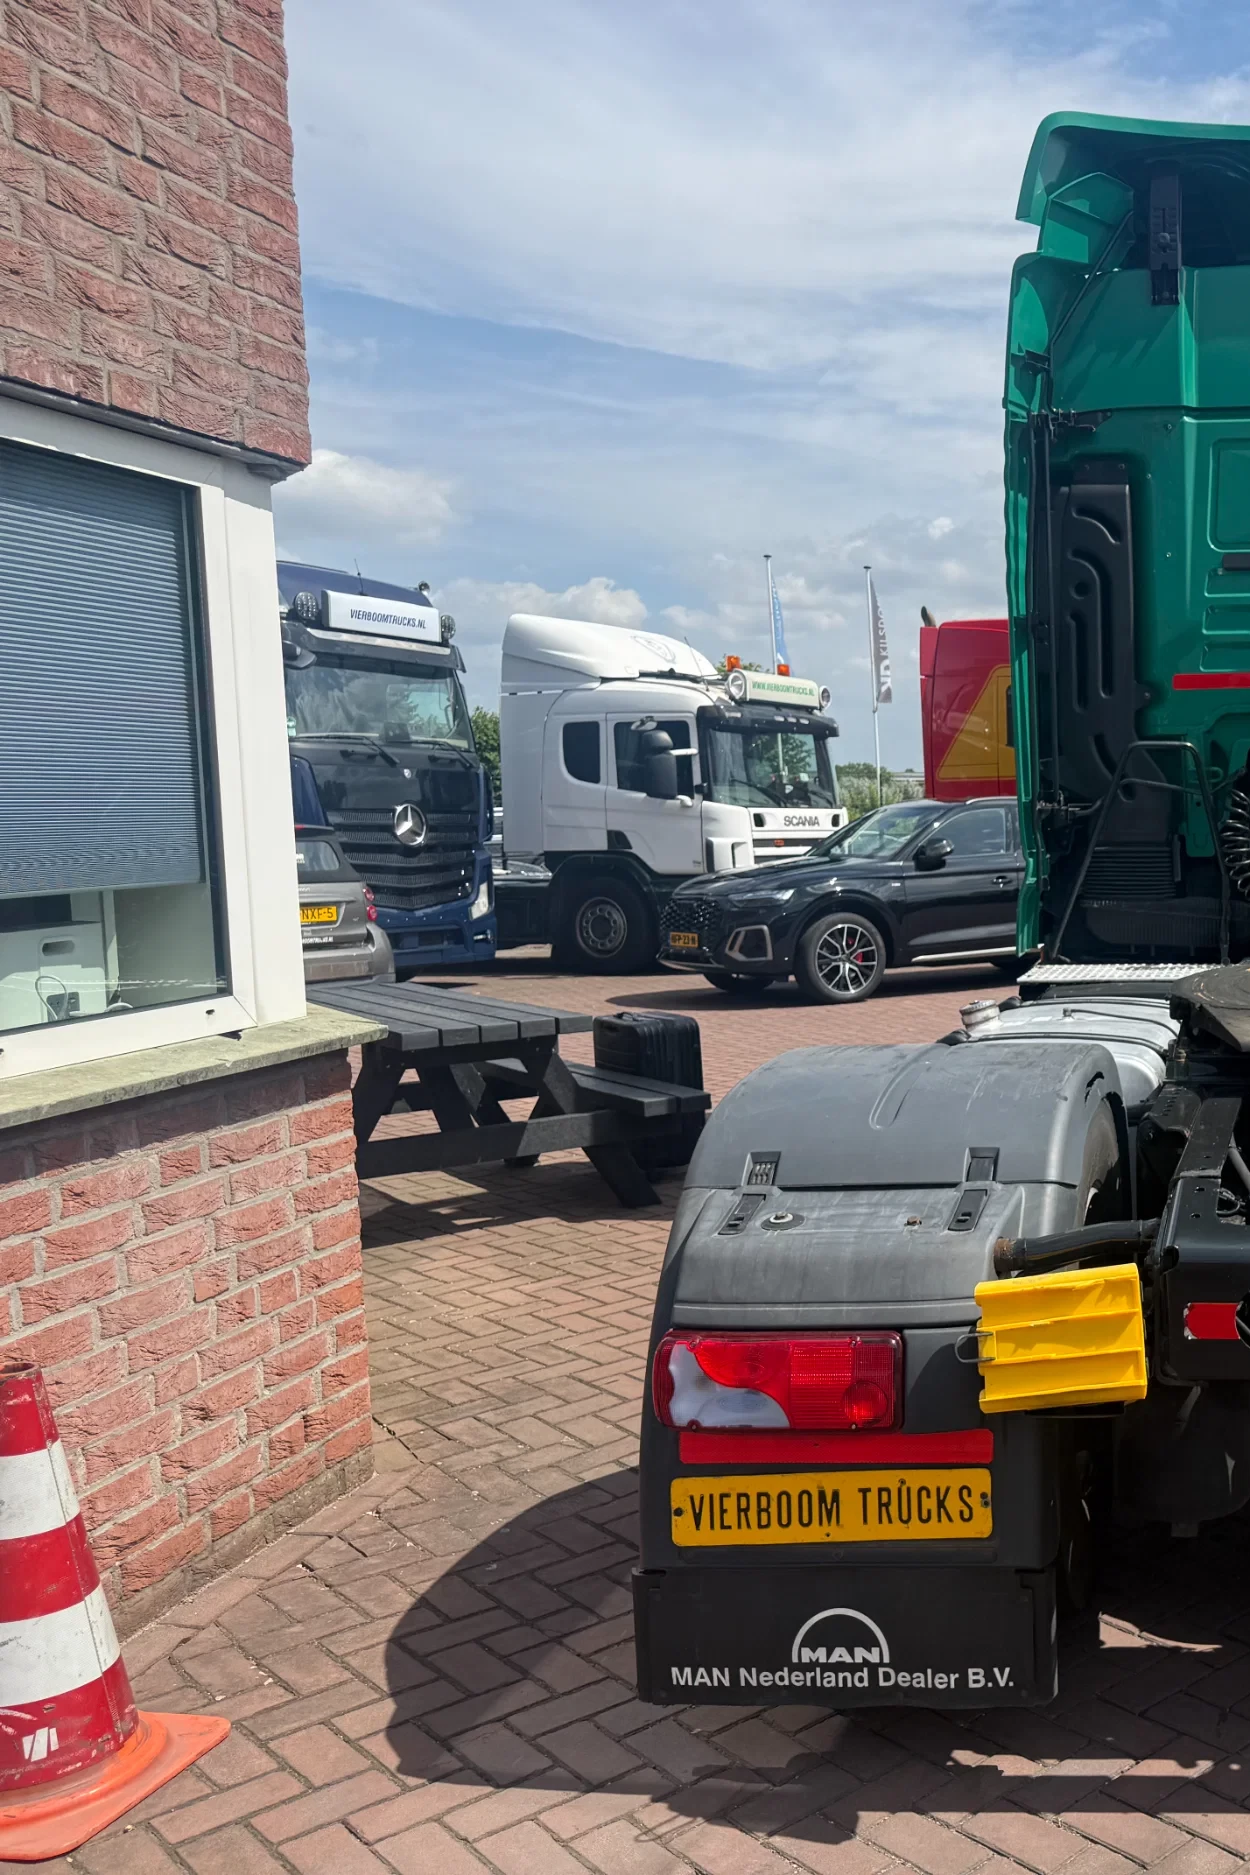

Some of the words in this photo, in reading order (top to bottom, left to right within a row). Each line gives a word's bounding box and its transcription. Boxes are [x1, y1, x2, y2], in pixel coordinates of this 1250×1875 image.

[350, 608, 427, 629] VIERBOOMTRUCKS.NL
[752, 681, 815, 696] WWW.VIERBOOMTRUCKS.NL
[784, 816, 820, 826] SCANIA
[689, 1488, 841, 1530] VIERBOOM
[858, 1484, 974, 1525] TRUCKS
[800, 1646, 880, 1663] MAN
[671, 1667, 730, 1687] MAN
[740, 1667, 869, 1688] Nederland
[878, 1667, 960, 1689] Dealer
[967, 1667, 1016, 1689] B.V.
